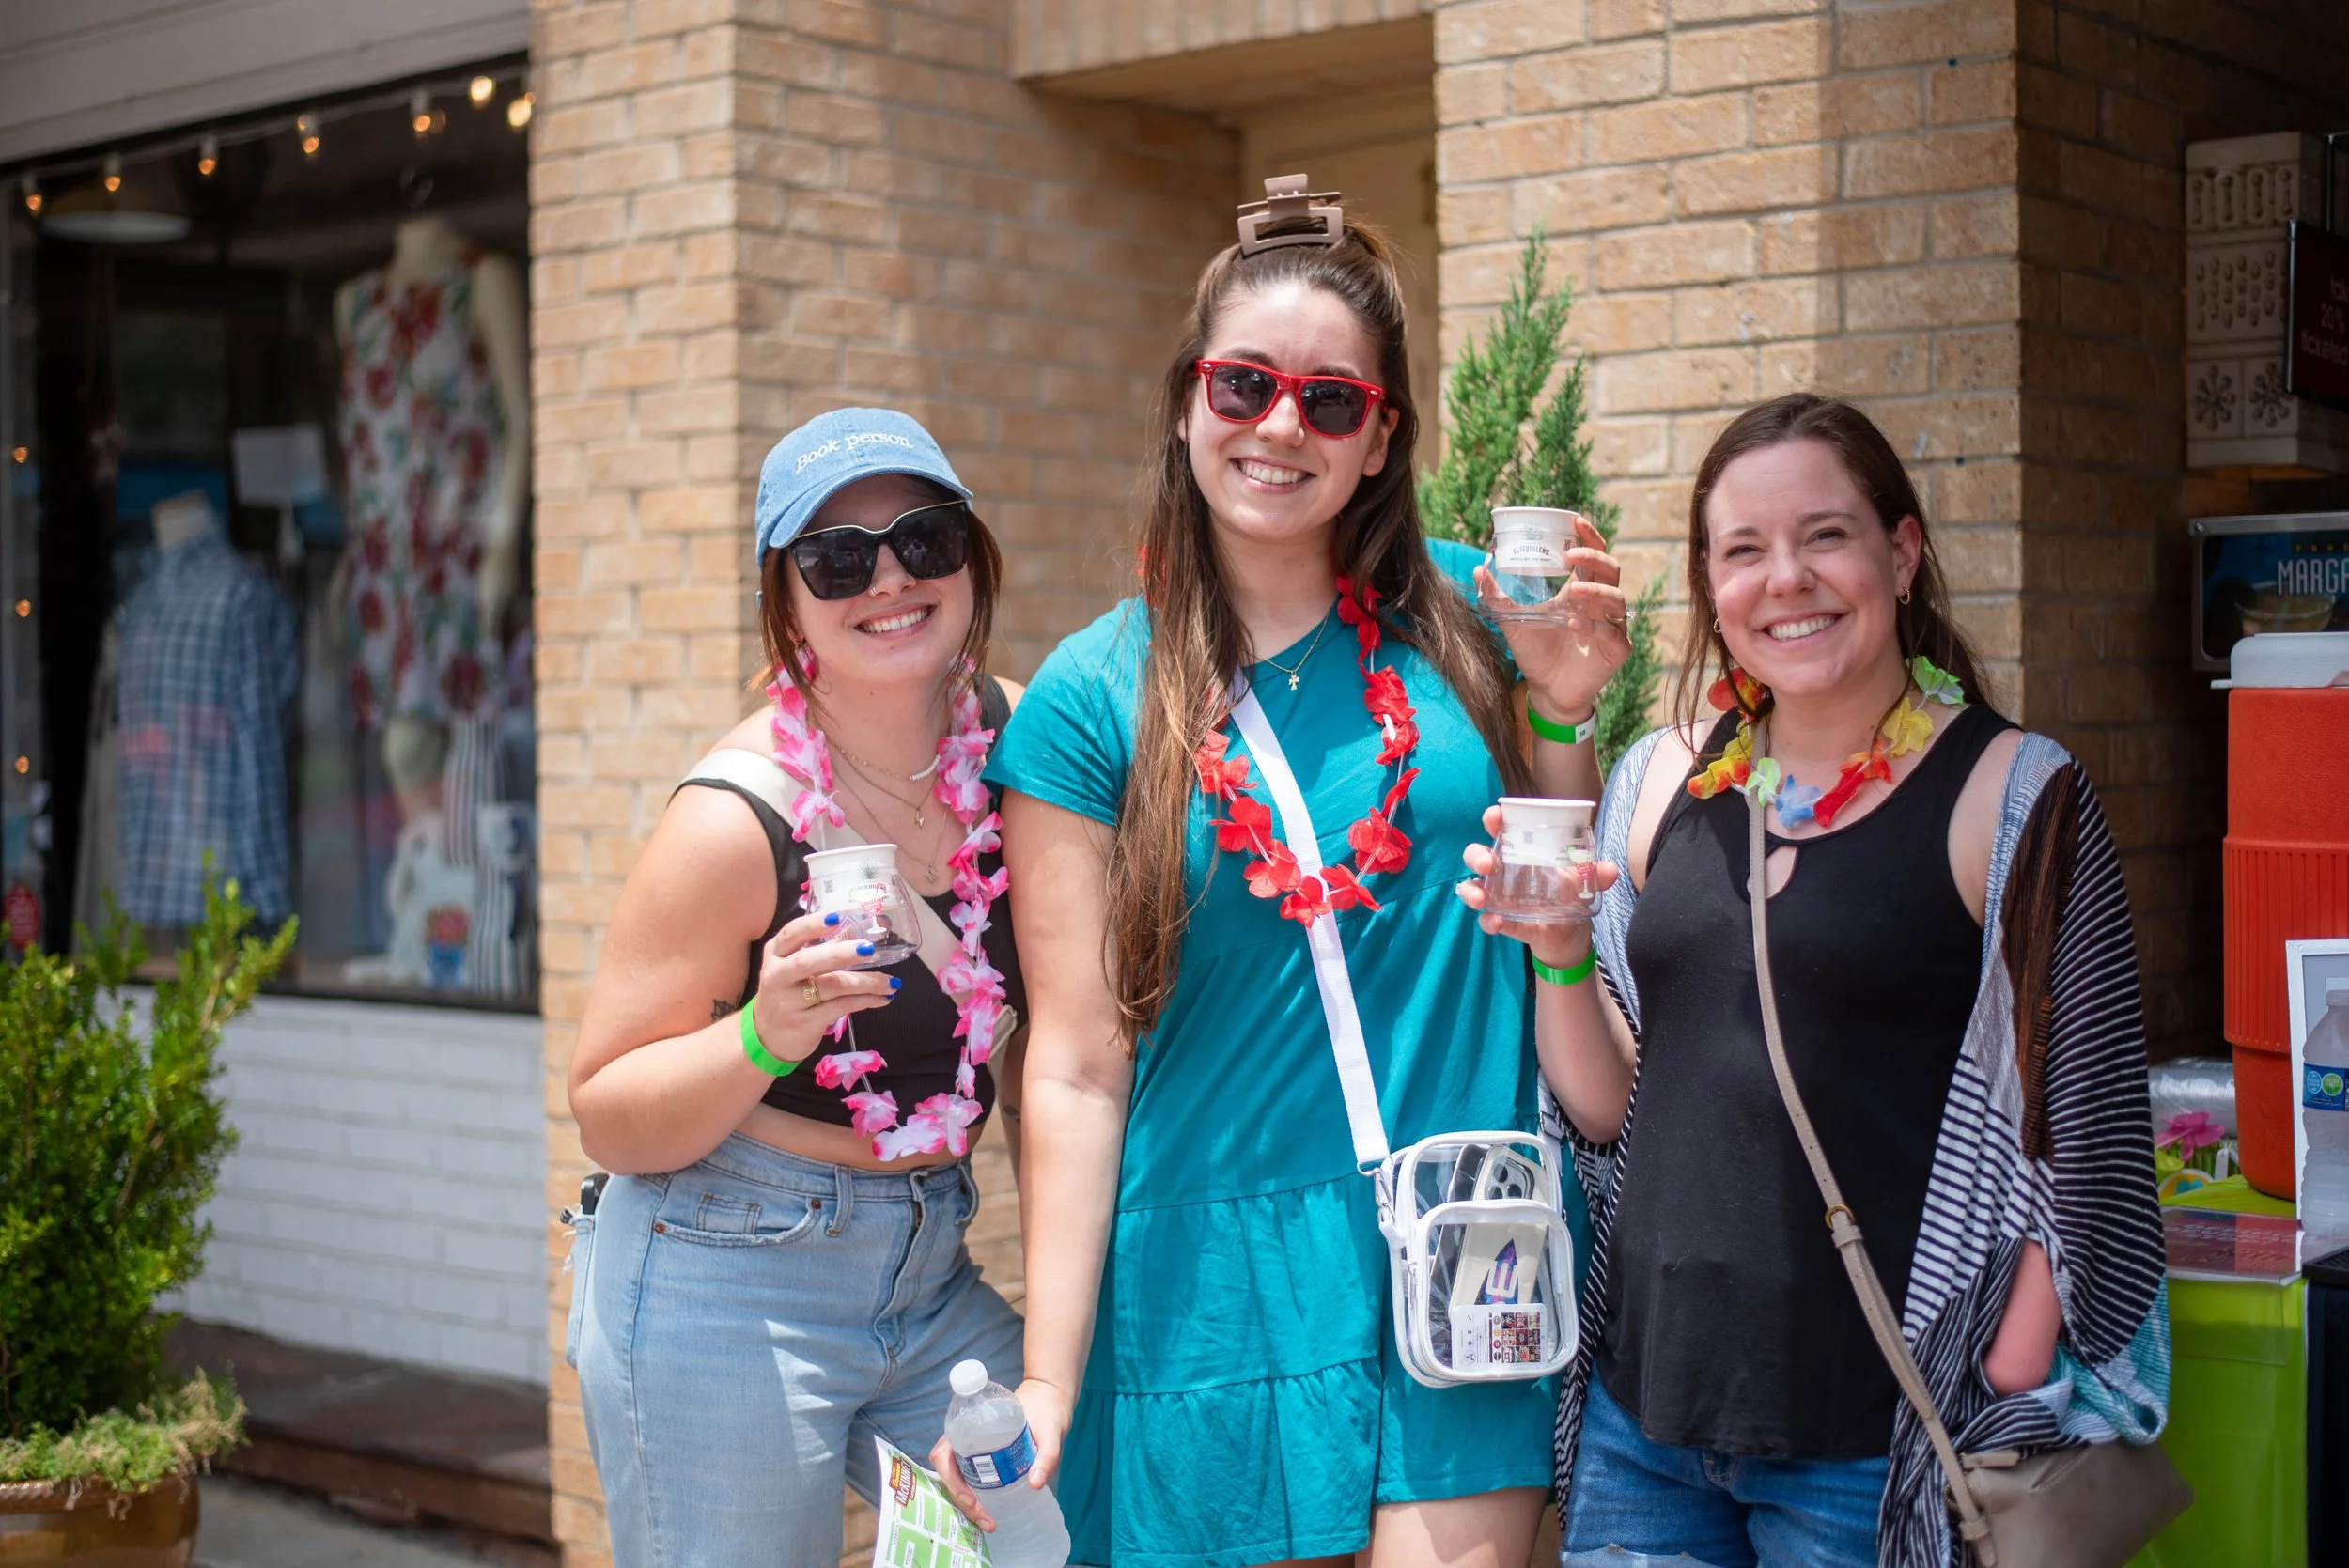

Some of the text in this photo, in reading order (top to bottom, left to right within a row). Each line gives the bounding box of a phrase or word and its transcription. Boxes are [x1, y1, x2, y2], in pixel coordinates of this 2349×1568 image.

[796, 439, 841, 474] Book
[2277, 557, 2349, 597] MARGA
[895, 1456, 912, 1505] McKINNEY
